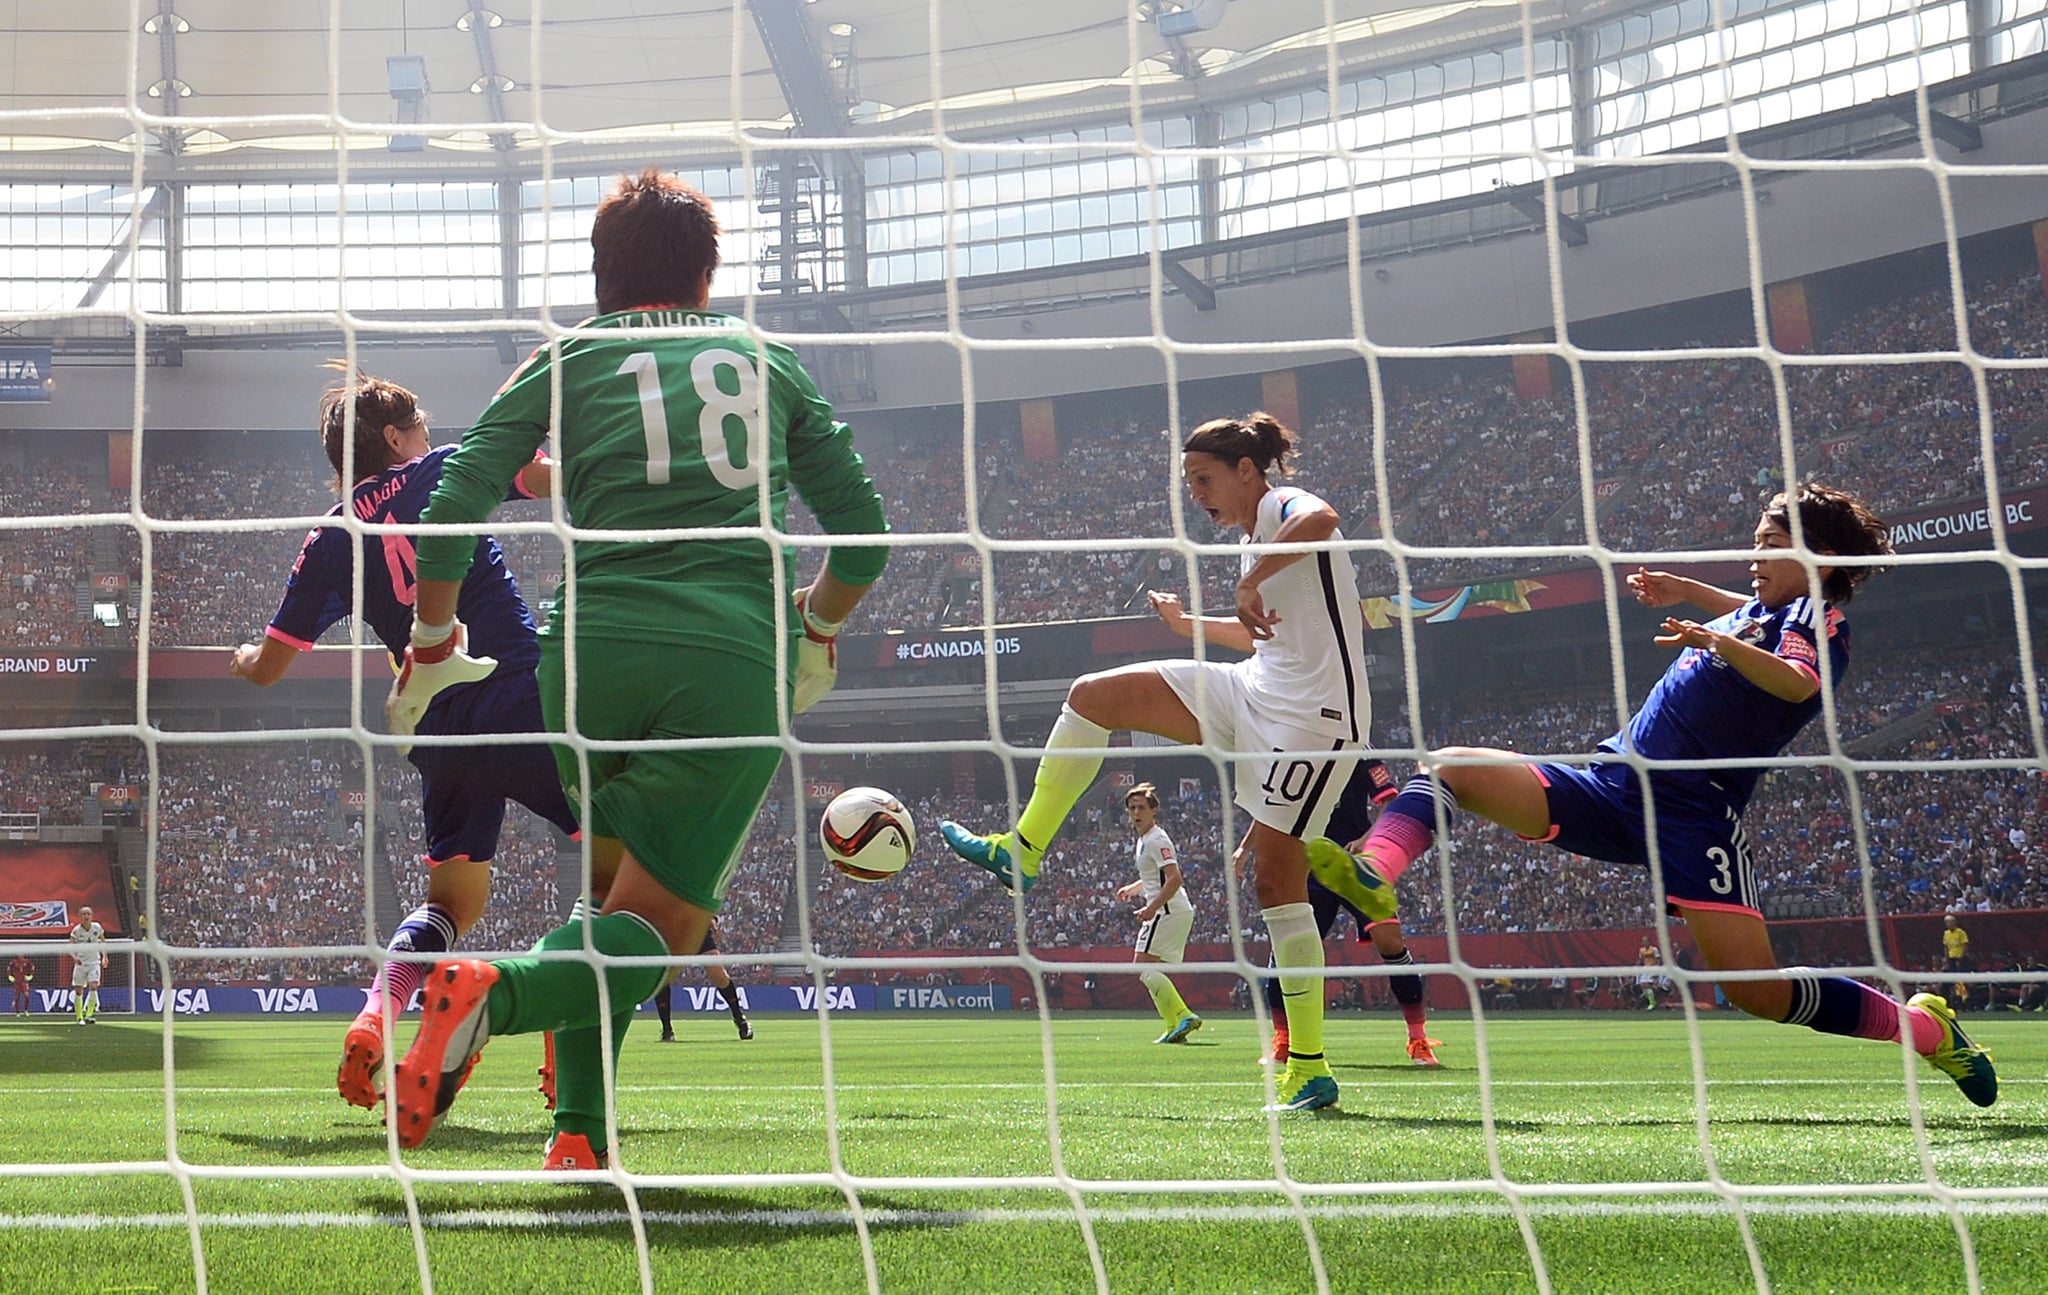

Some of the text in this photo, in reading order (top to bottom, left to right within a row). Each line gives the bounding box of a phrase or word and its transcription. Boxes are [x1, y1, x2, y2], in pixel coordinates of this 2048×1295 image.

[615, 348, 764, 490] 18
[2005, 501, 2033, 524] BC
[101, 576, 119, 587] 401
[896, 637, 1021, 660] #CANADA015
[1262, 747, 1315, 802] 10
[110, 787, 128, 799] 201
[812, 785, 836, 798] 204
[1706, 846, 1732, 895] 3
[252, 988, 319, 1012] VISA
